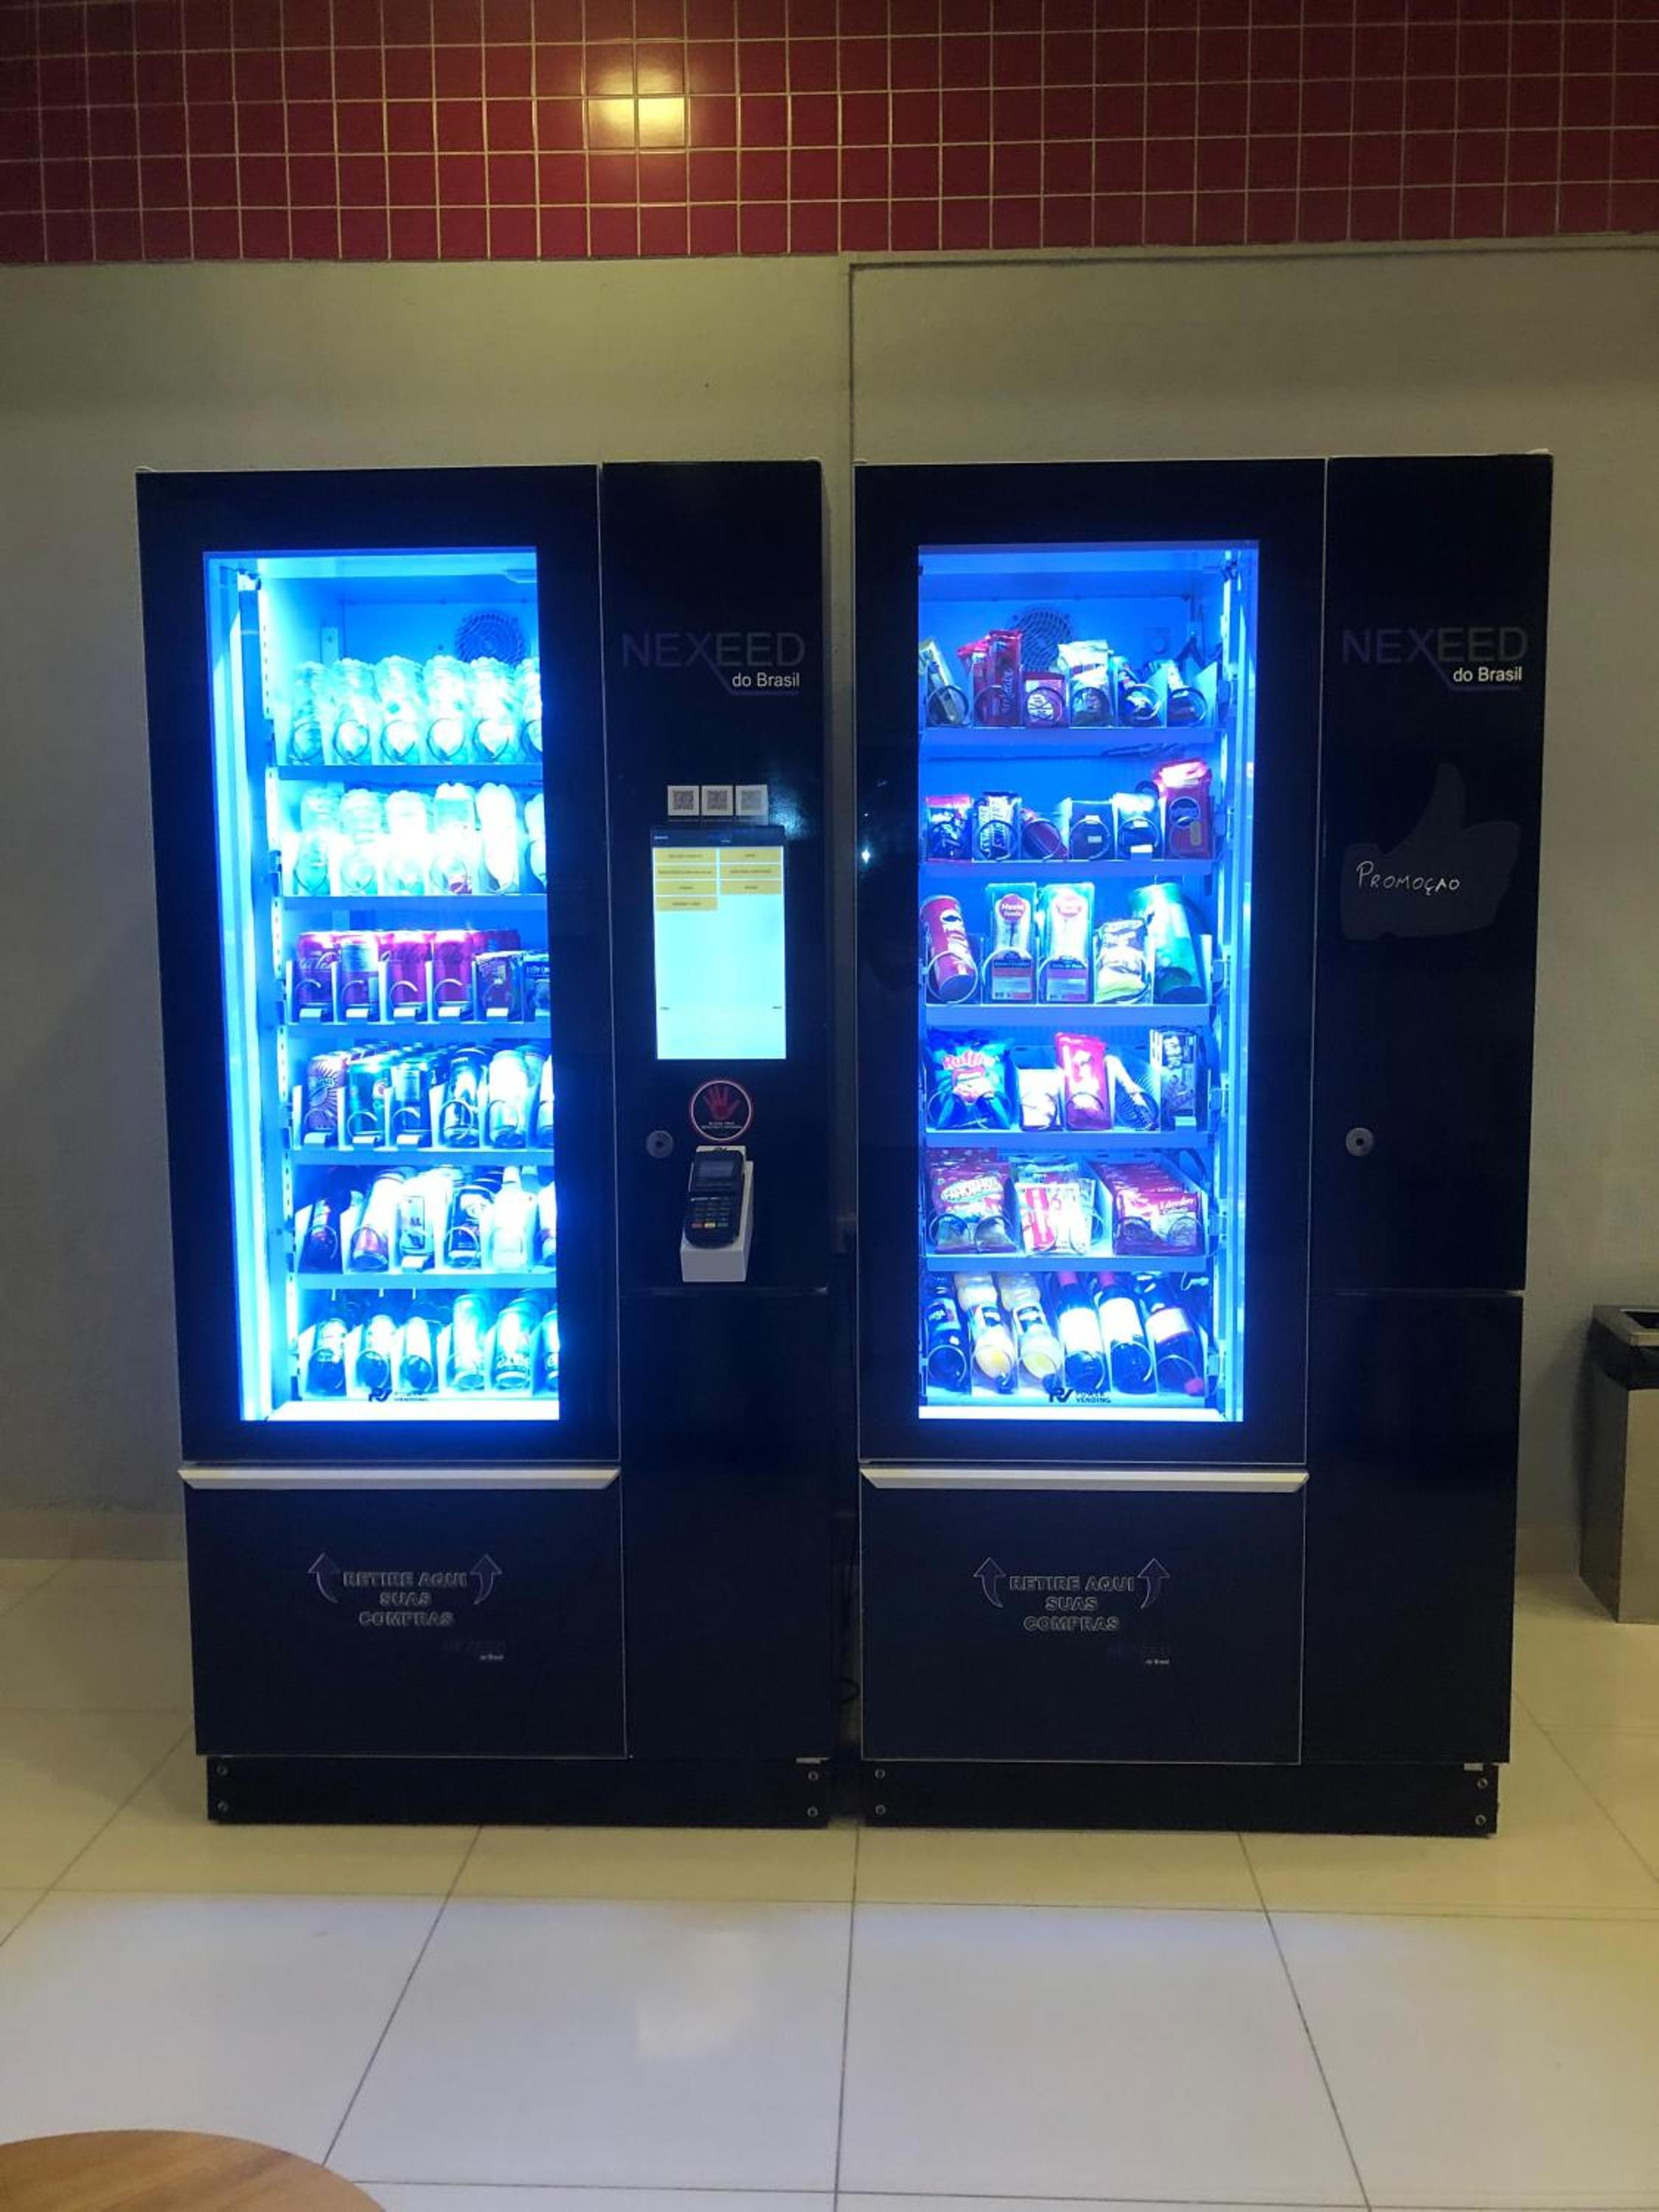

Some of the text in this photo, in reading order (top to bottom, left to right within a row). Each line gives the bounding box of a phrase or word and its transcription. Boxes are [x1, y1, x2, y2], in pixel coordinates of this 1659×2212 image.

[622, 632, 806, 667] NEXEED
[1341, 627, 1527, 664] NEXEED
[731, 672, 800, 687] do Brasil
[1453, 666, 1523, 682] do Brasil
[342, 1571, 467, 1587] RETIRE AQUI
[1009, 1575, 1134, 1591] RETIRE AQUI
[379, 1591, 432, 1607] SUAS
[1045, 1596, 1098, 1611] SUAS
[358, 1611, 455, 1627] COMPRAS
[1023, 1615, 1121, 1632] COMPRAS
